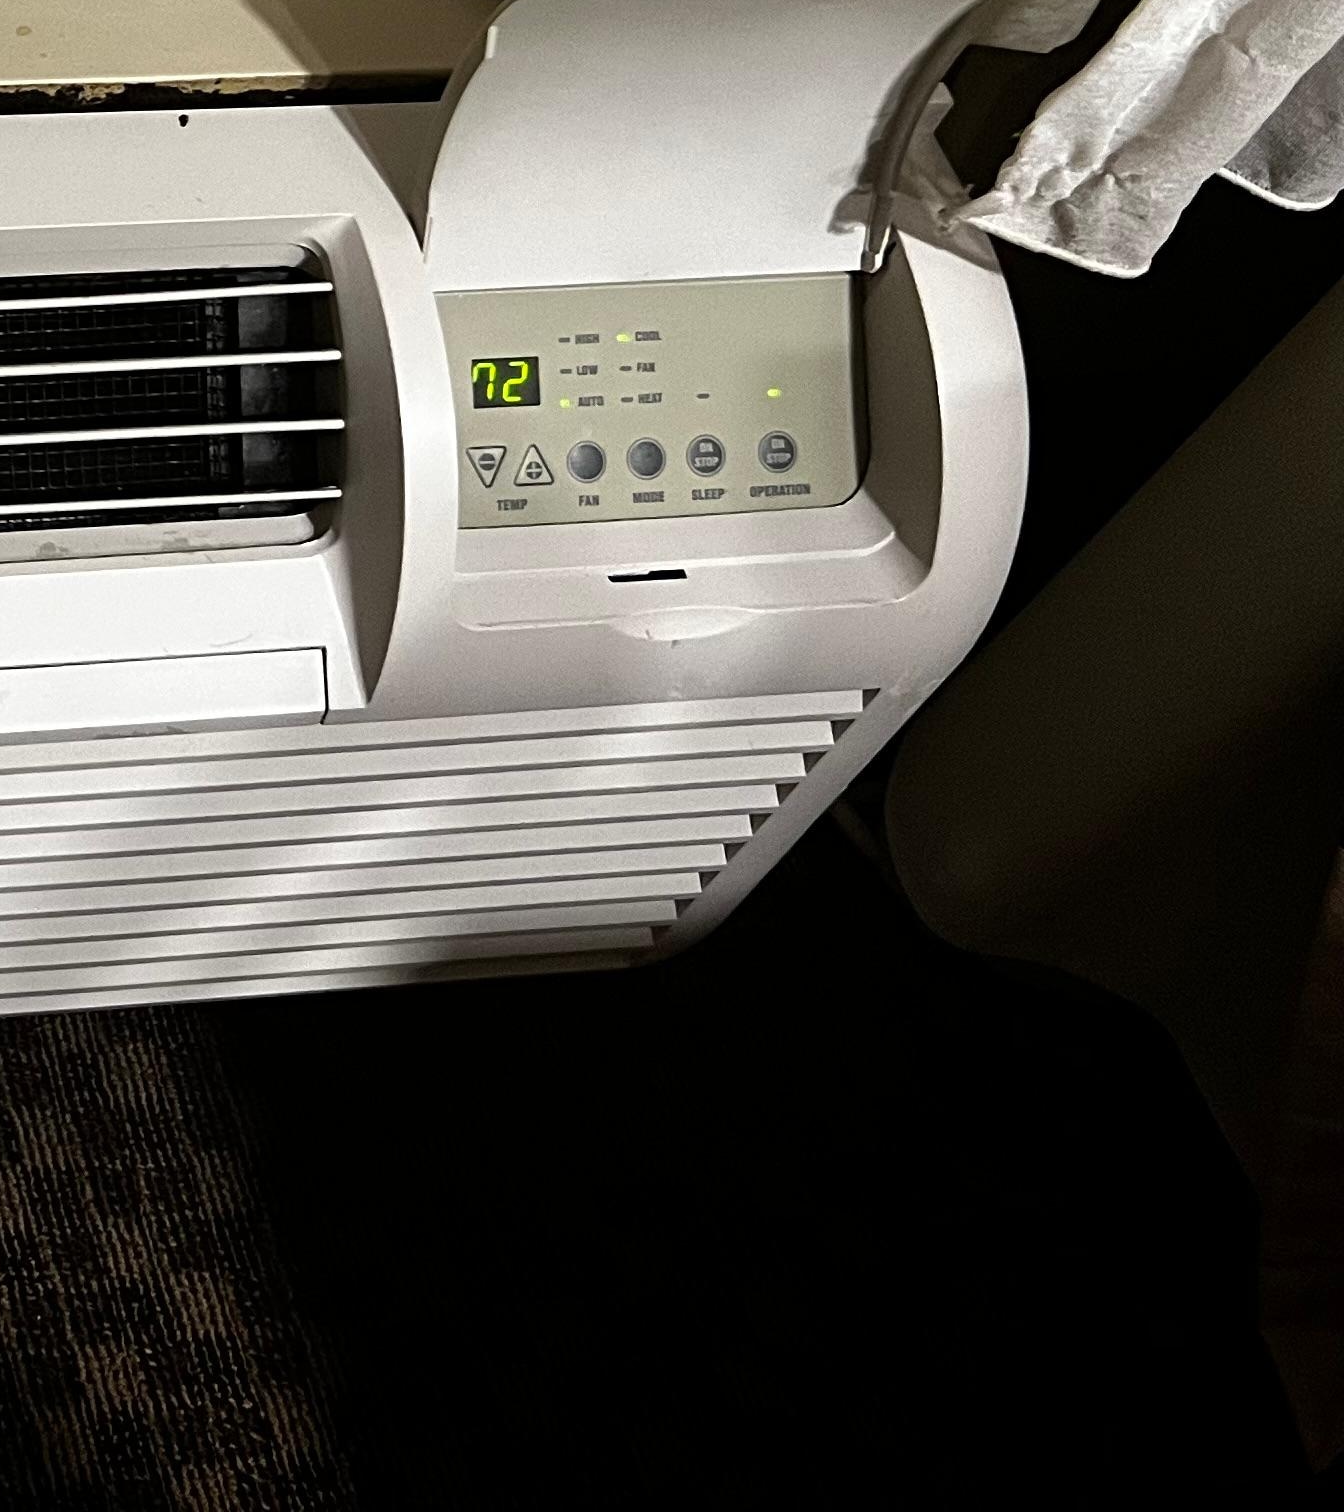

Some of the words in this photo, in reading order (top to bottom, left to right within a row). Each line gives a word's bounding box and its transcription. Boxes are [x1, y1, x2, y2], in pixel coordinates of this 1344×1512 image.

[576, 365, 598, 375] LOW
[637, 362, 655, 372] FAN
[472, 360, 529, 402] 72
[578, 396, 604, 406] AUTO
[694, 457, 719, 467] STOP
[692, 488, 725, 500] SLEEP
[750, 483, 811, 497] OPERATION
[579, 495, 599, 506] FAN
[632, 491, 664, 503] MODE
[497, 499, 528, 511] TEMP
